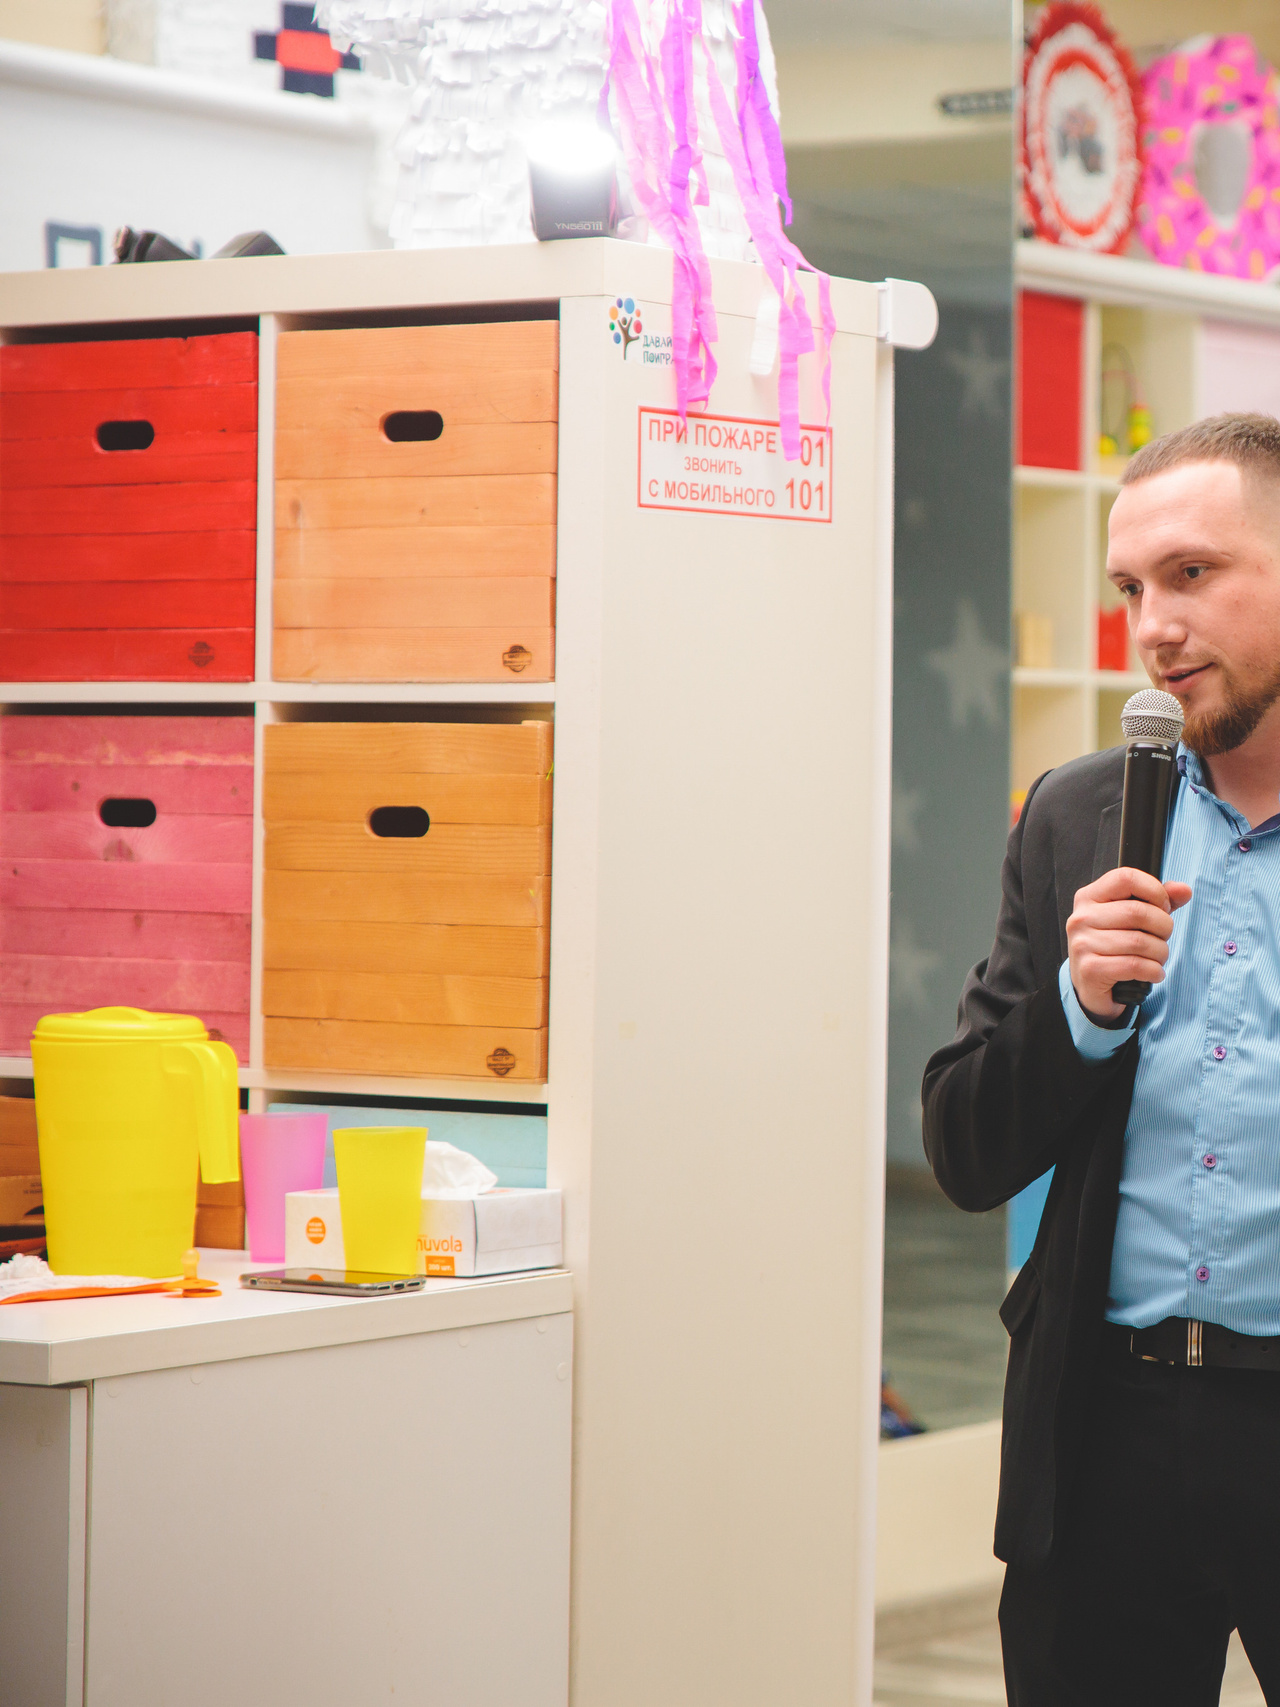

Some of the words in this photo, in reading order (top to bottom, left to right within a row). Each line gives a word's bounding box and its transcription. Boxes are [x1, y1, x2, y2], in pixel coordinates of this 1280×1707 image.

[648, 418, 688, 445] ПРИ
[695, 423, 777, 453] ПОЖАРЕ
[800, 435, 824, 467] 01
[684, 456, 742, 475] ЗВОНИТЬ
[648, 479, 659, 498] С
[664, 480, 775, 507] МОБИЛЬНОГО
[785, 477, 824, 512] 101
[415, 1235, 463, 1252] nuvola
